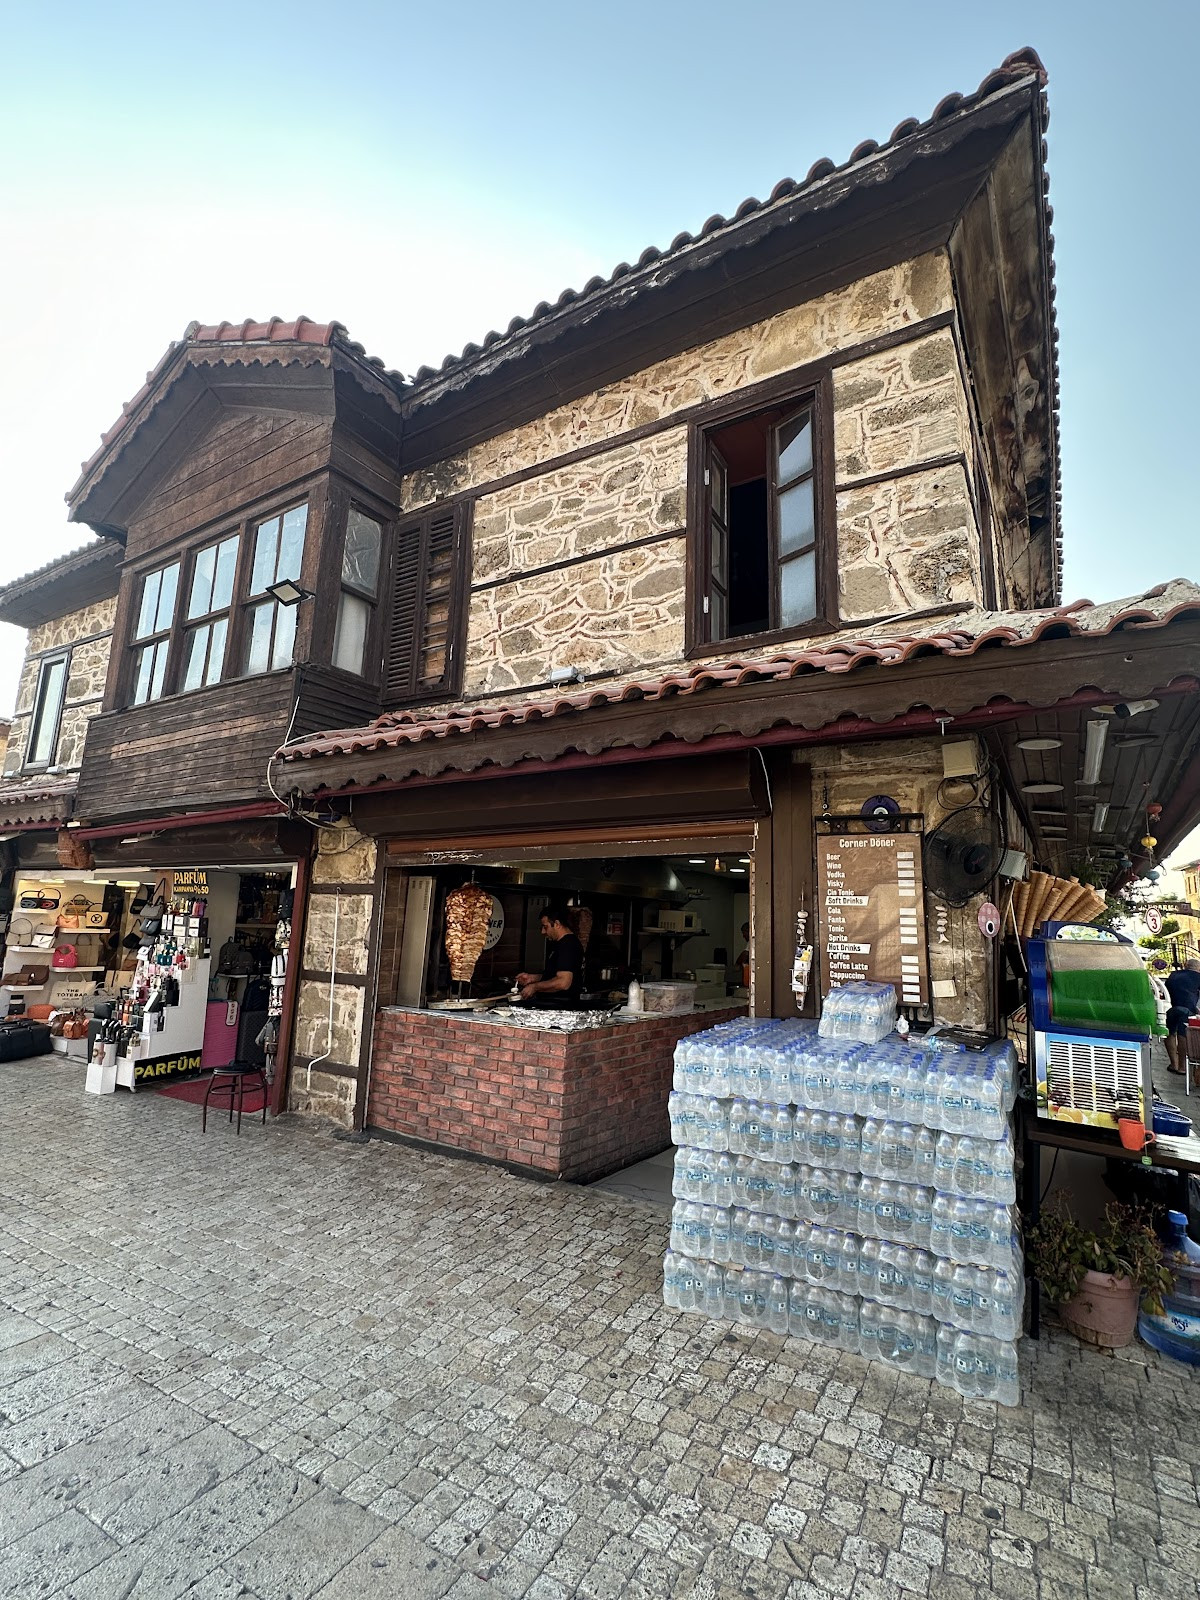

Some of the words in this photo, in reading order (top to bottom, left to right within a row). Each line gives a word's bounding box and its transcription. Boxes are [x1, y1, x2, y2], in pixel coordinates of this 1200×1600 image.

[840, 839, 868, 848] Corner
[869, 837, 896, 848] Döner
[826, 853, 841, 861] Beer
[826, 862, 841, 870] Wine
[174, 868, 207, 885] PARFÜM
[826, 871, 845, 879] Vodka
[827, 880, 844, 889] Visky
[827, 907, 841, 915] Cola
[828, 916, 846, 924] Fanta
[1151, 918, 1158, 930] 3
[828, 925, 845, 933] Tonic
[828, 934, 848, 942] Sprite
[840, 944, 861, 952] Drinks
[829, 962, 851, 970] Coffee
[851, 963, 869, 971] Latte
[829, 971, 866, 980] Cappuccino
[830, 980, 841, 988] Tea
[134, 1056, 202, 1080] PARFÜM
